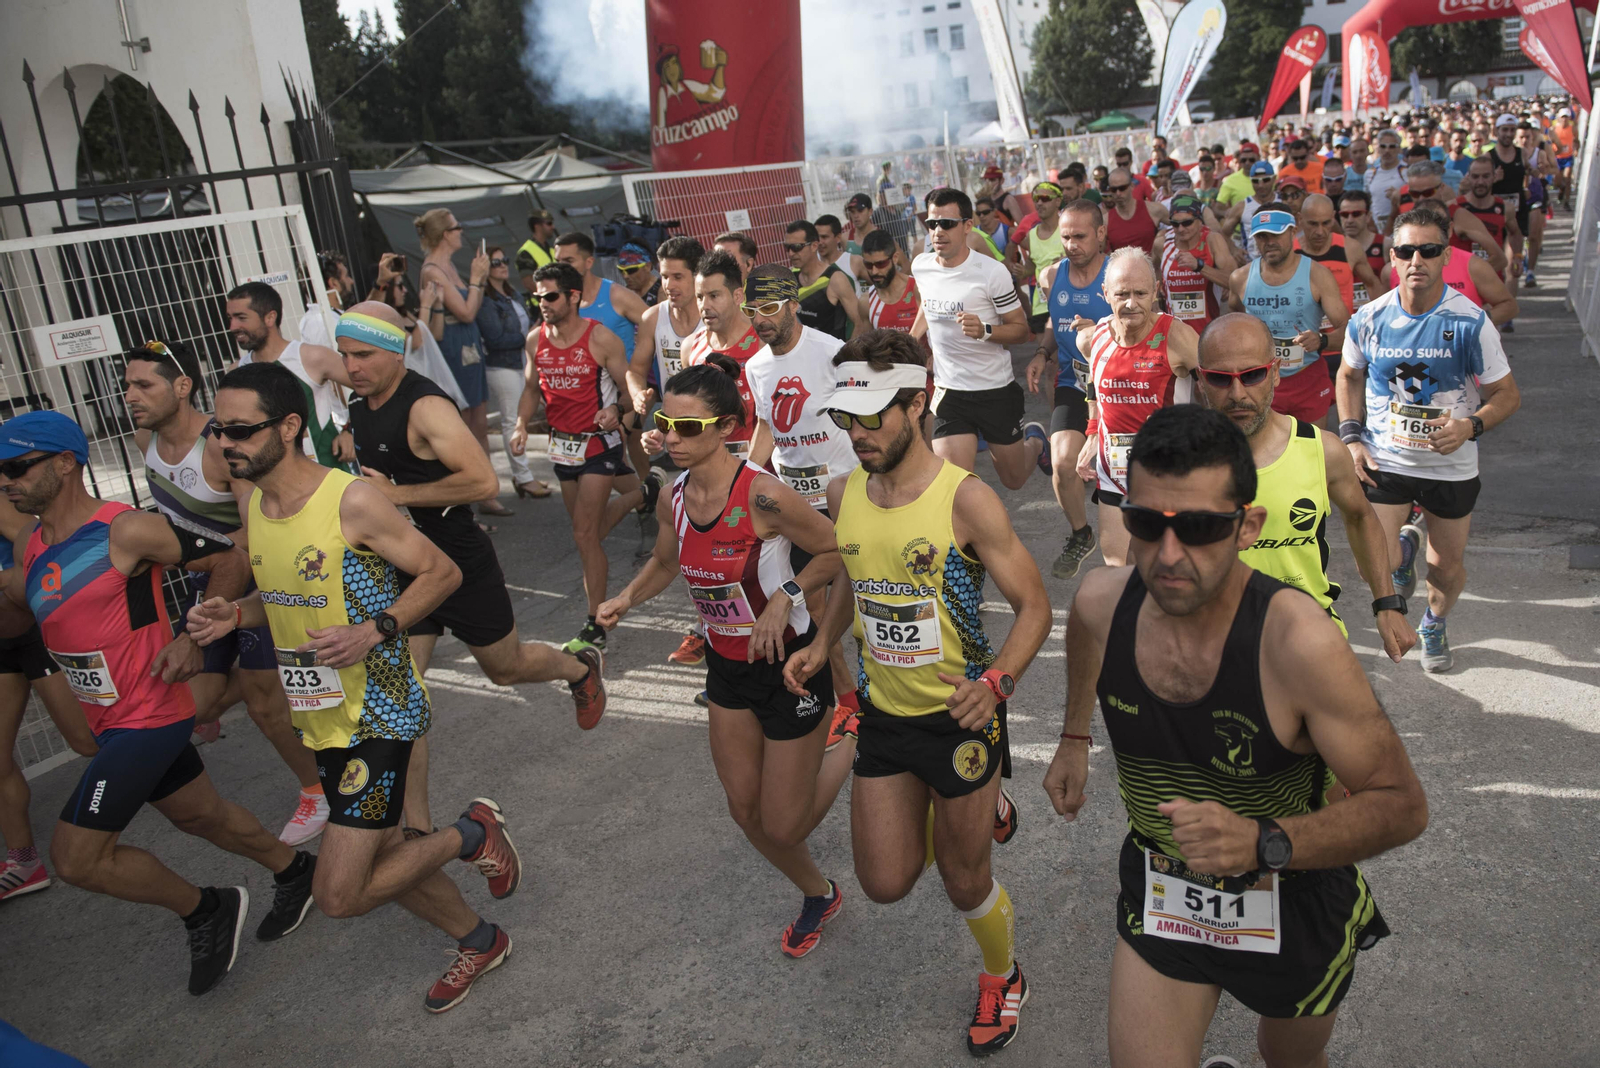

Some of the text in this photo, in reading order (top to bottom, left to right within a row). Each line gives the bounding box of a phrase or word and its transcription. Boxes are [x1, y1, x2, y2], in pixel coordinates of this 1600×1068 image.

[652, 104, 739, 147] Cruzcampo
[1168, 278, 1205, 286] Polisalud
[927, 298, 964, 312] TEXCON
[1178, 300, 1197, 310] 768
[1248, 294, 1290, 309] nerja
[62, 329, 92, 340] ALQUISUR
[341, 319, 399, 343] SPORTIVA
[1378, 348, 1452, 358] TODO SUMA
[546, 376, 580, 389] Vélez
[836, 377, 868, 388] IRONMAN
[1101, 378, 1150, 390] Clínicas
[1100, 394, 1158, 404] Polisalud
[800, 430, 830, 446] FUERA
[562, 442, 582, 453] 147
[792, 478, 821, 491] 298
[680, 564, 725, 580] Clínicas
[696, 601, 740, 618] 3001
[868, 602, 889, 612] FUERZAS
[876, 622, 921, 643] 562
[877, 642, 895, 650] MANU
[870, 647, 890, 662] AMARGA
[898, 656, 916, 664] PICA
[66, 669, 102, 687] 1526
[284, 669, 322, 687] 233
[1118, 698, 1138, 715] barri
[1212, 710, 1224, 718] CLUB
[1224, 710, 1232, 718] DE
[1210, 756, 1257, 777] HUELMA 2003
[1172, 866, 1214, 883] AMADAS
[1153, 886, 1165, 894] M40
[1184, 886, 1244, 919] 511
[1192, 914, 1239, 928] CARRIQUI
[1156, 920, 1239, 945] AMARGA Y PICA
